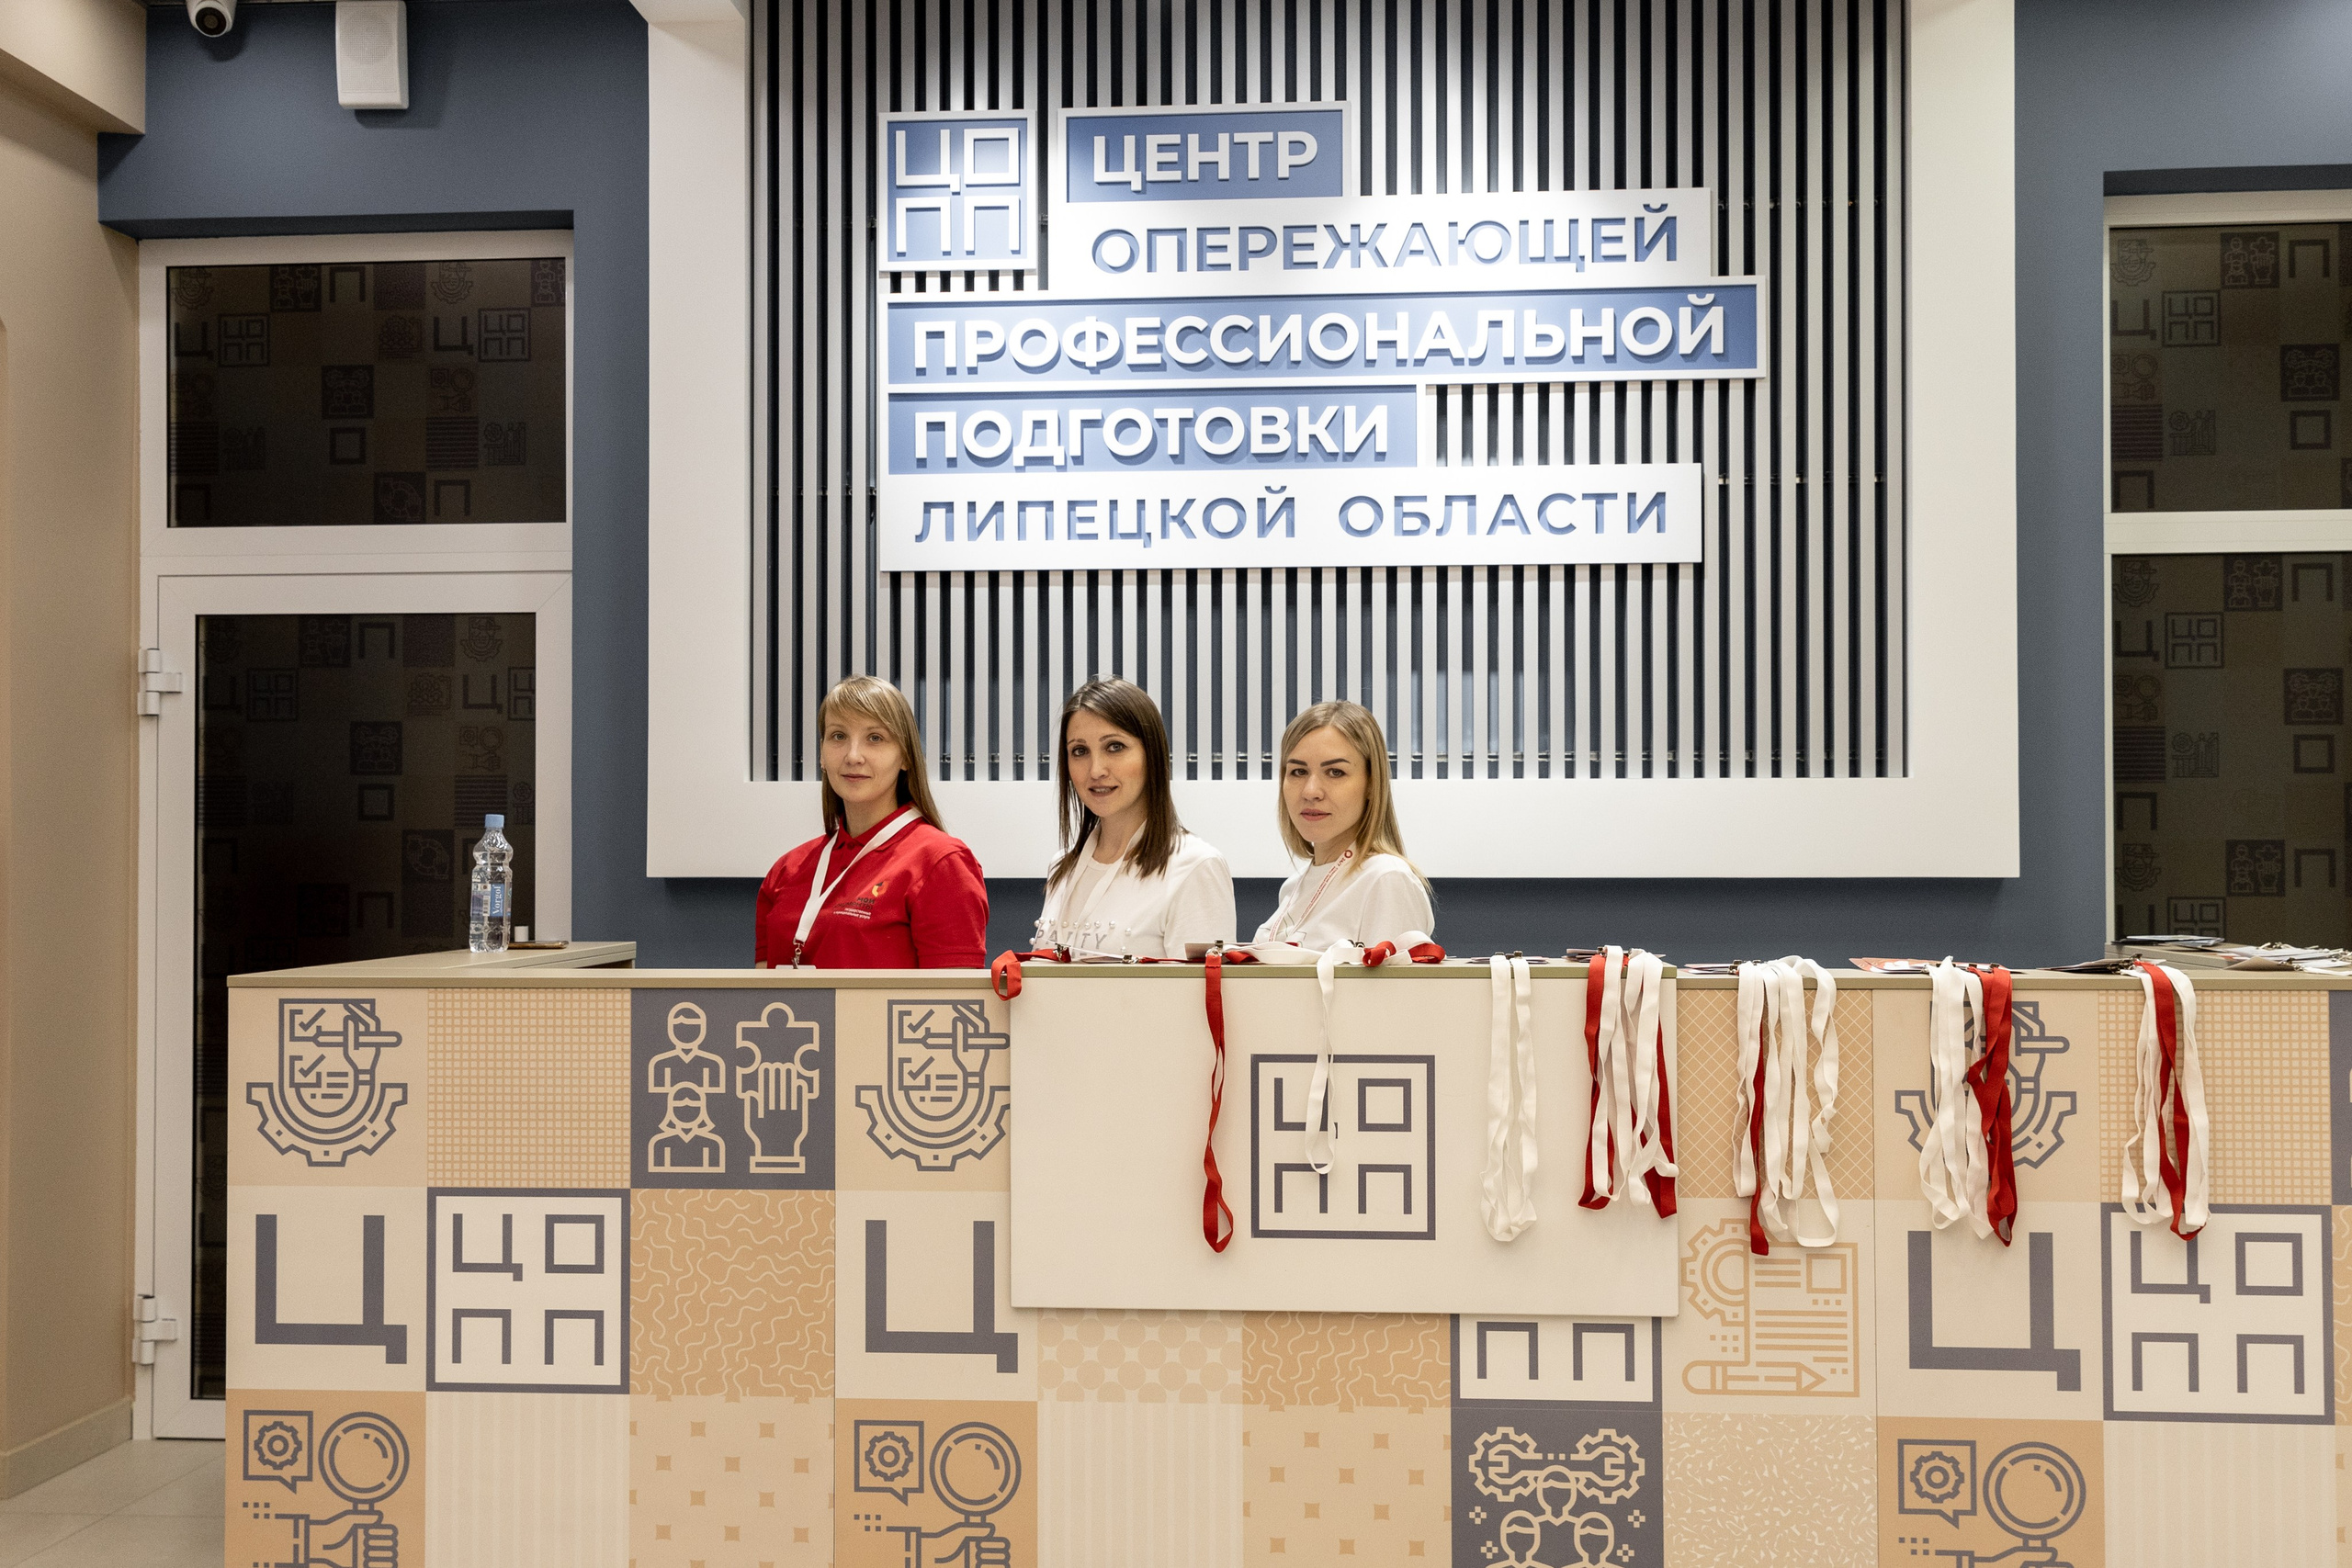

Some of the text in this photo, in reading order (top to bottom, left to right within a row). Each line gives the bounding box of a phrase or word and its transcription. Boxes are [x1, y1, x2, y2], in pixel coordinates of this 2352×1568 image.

[1093, 130, 1317, 191] ЦЕНТР
[1091, 203, 1678, 273] ОПЕРЕЖАЮЩЕЙ
[913, 293, 1724, 368] ПРОФЕССИОНАЛЬНОЙ
[914, 404, 1388, 467] ПОДГОТОВКИ
[914, 485, 1667, 547] ЛИПЕЦКОЙ ОБЛАСТИ
[492, 886, 503, 915] Vorgol
